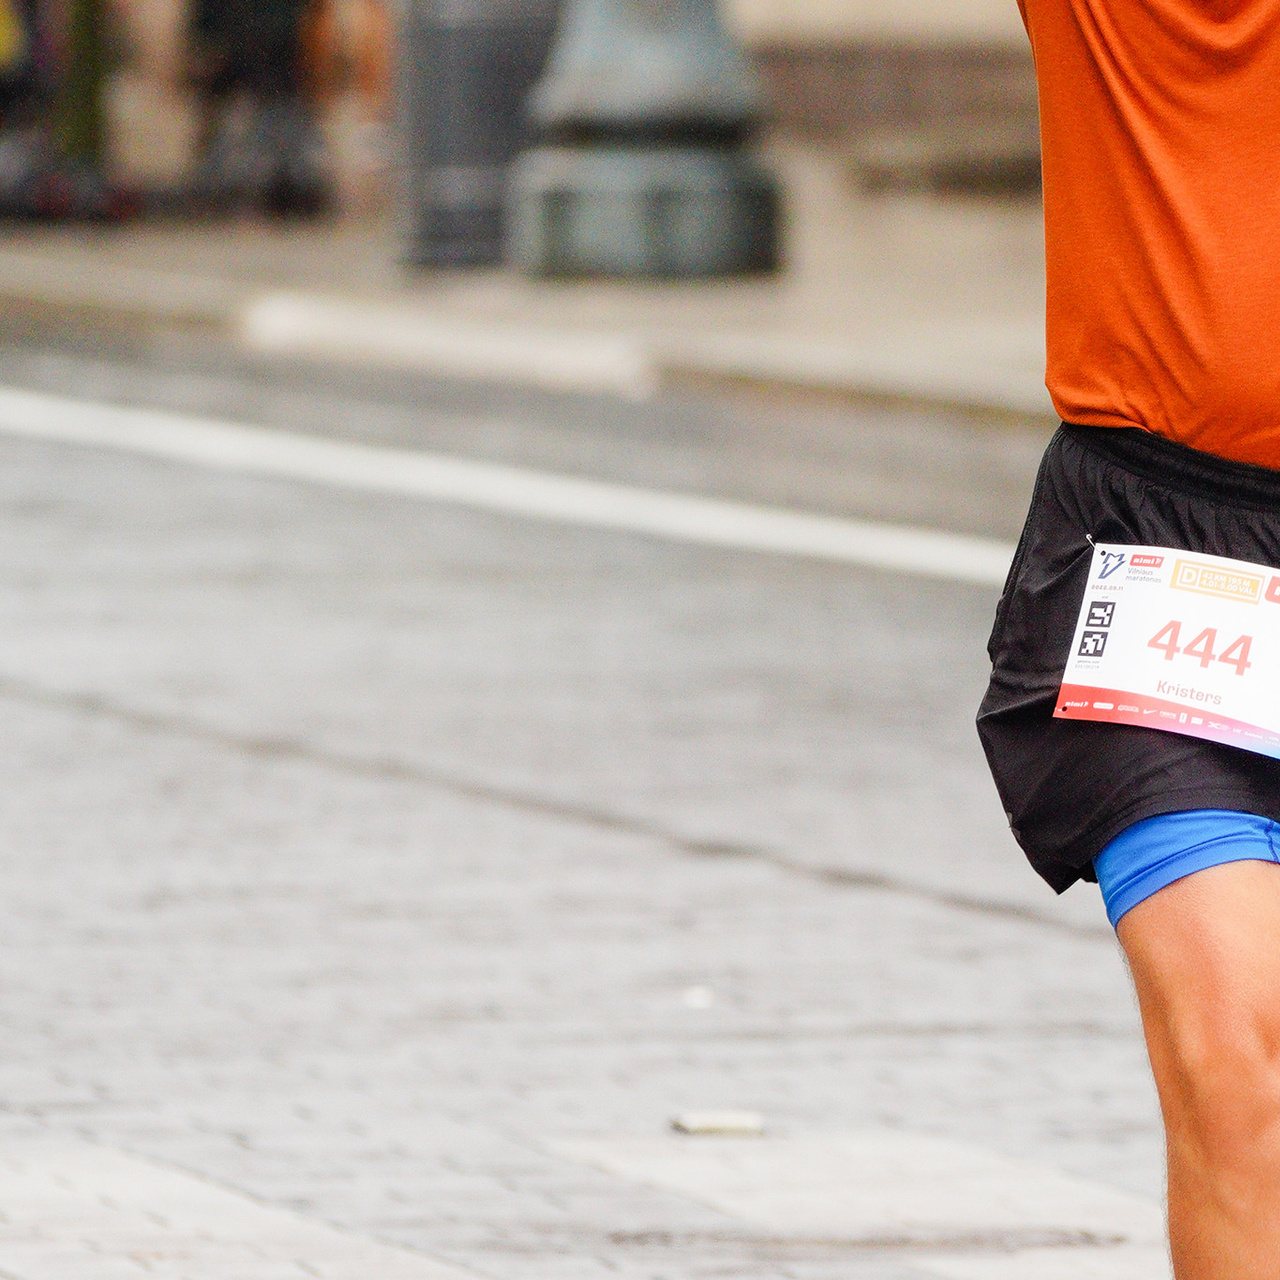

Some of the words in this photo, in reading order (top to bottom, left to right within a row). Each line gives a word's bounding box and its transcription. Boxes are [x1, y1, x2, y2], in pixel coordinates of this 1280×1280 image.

[1181, 567, 1197, 583] D
[1147, 619, 1253, 677] 444
[1156, 680, 1223, 705] Kristers
